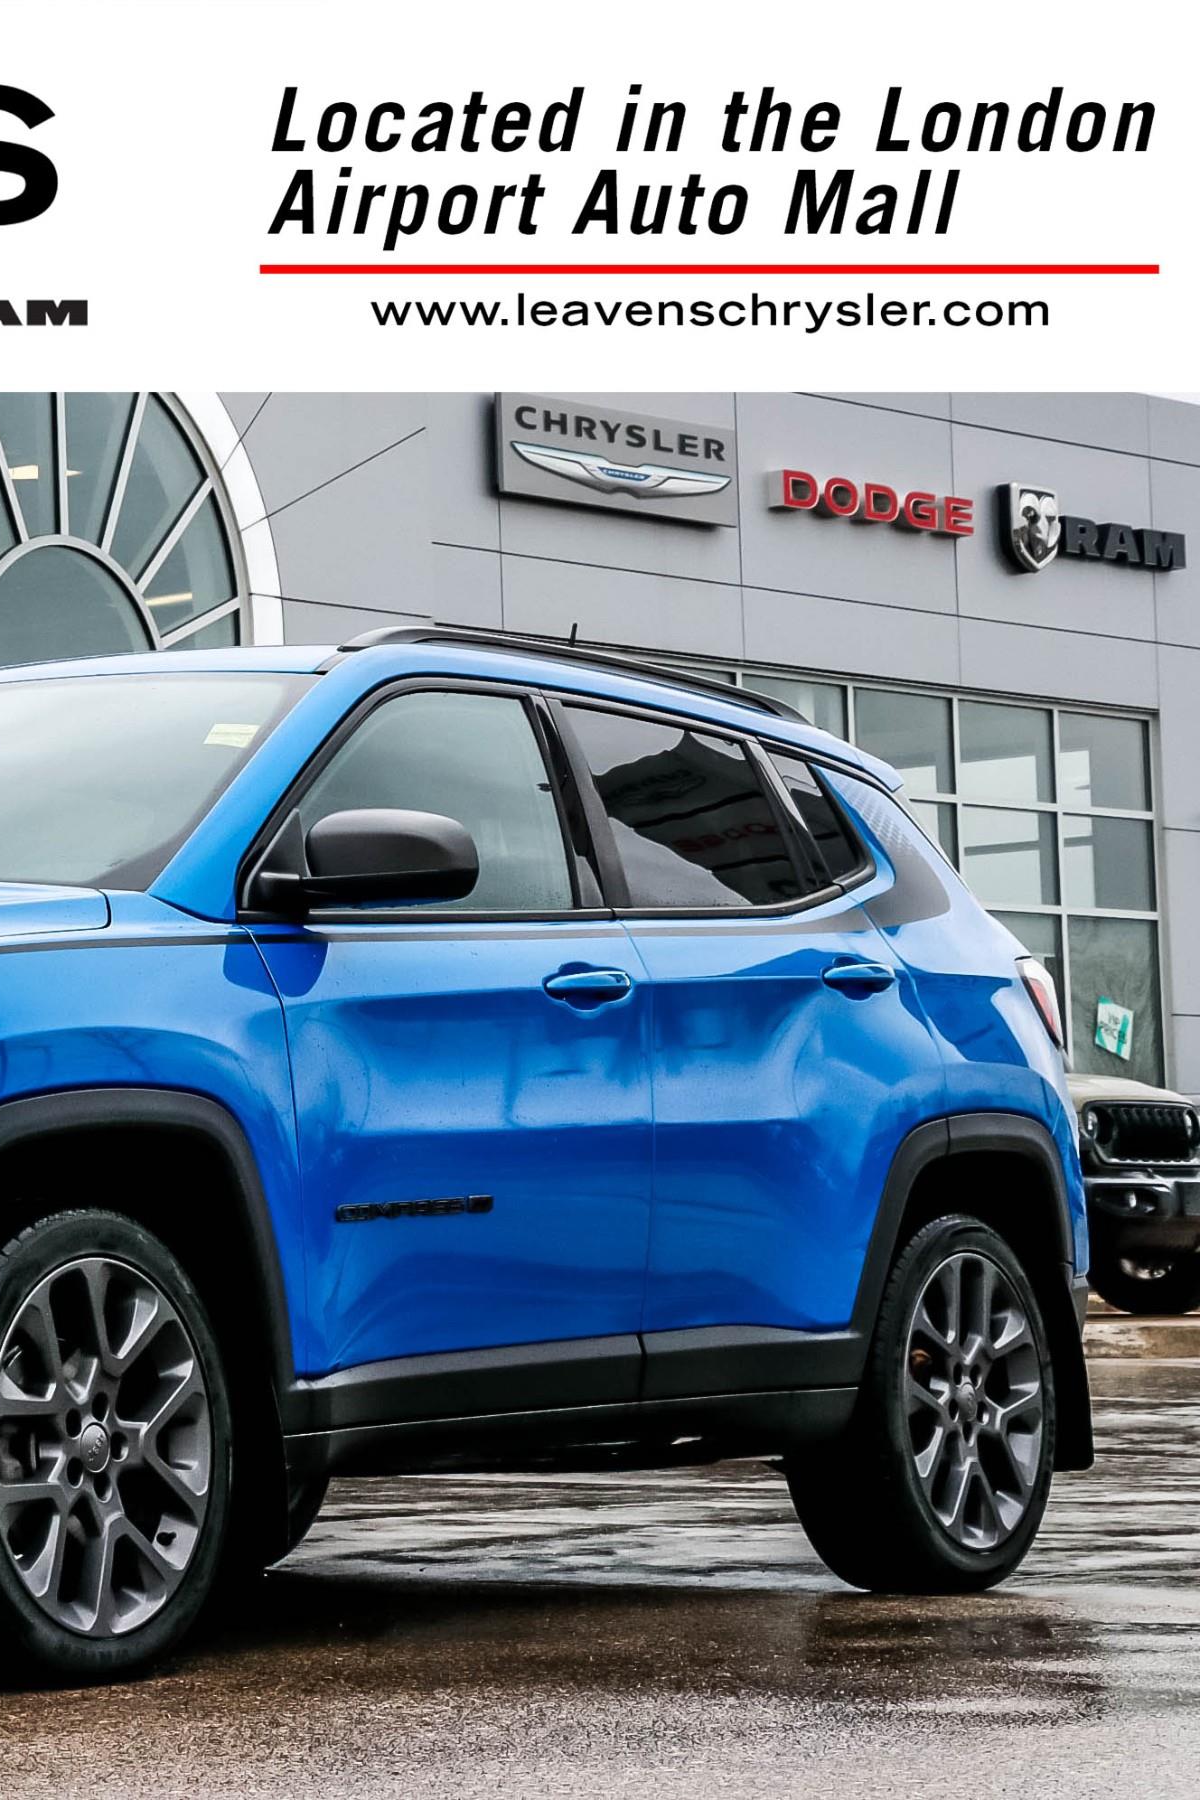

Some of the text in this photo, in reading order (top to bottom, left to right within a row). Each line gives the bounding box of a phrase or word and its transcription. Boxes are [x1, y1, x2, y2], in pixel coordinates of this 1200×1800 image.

[514, 405, 726, 462] CHRYSLER
[783, 469, 975, 536] DODGE
[1062, 515, 1186, 570] RAM
